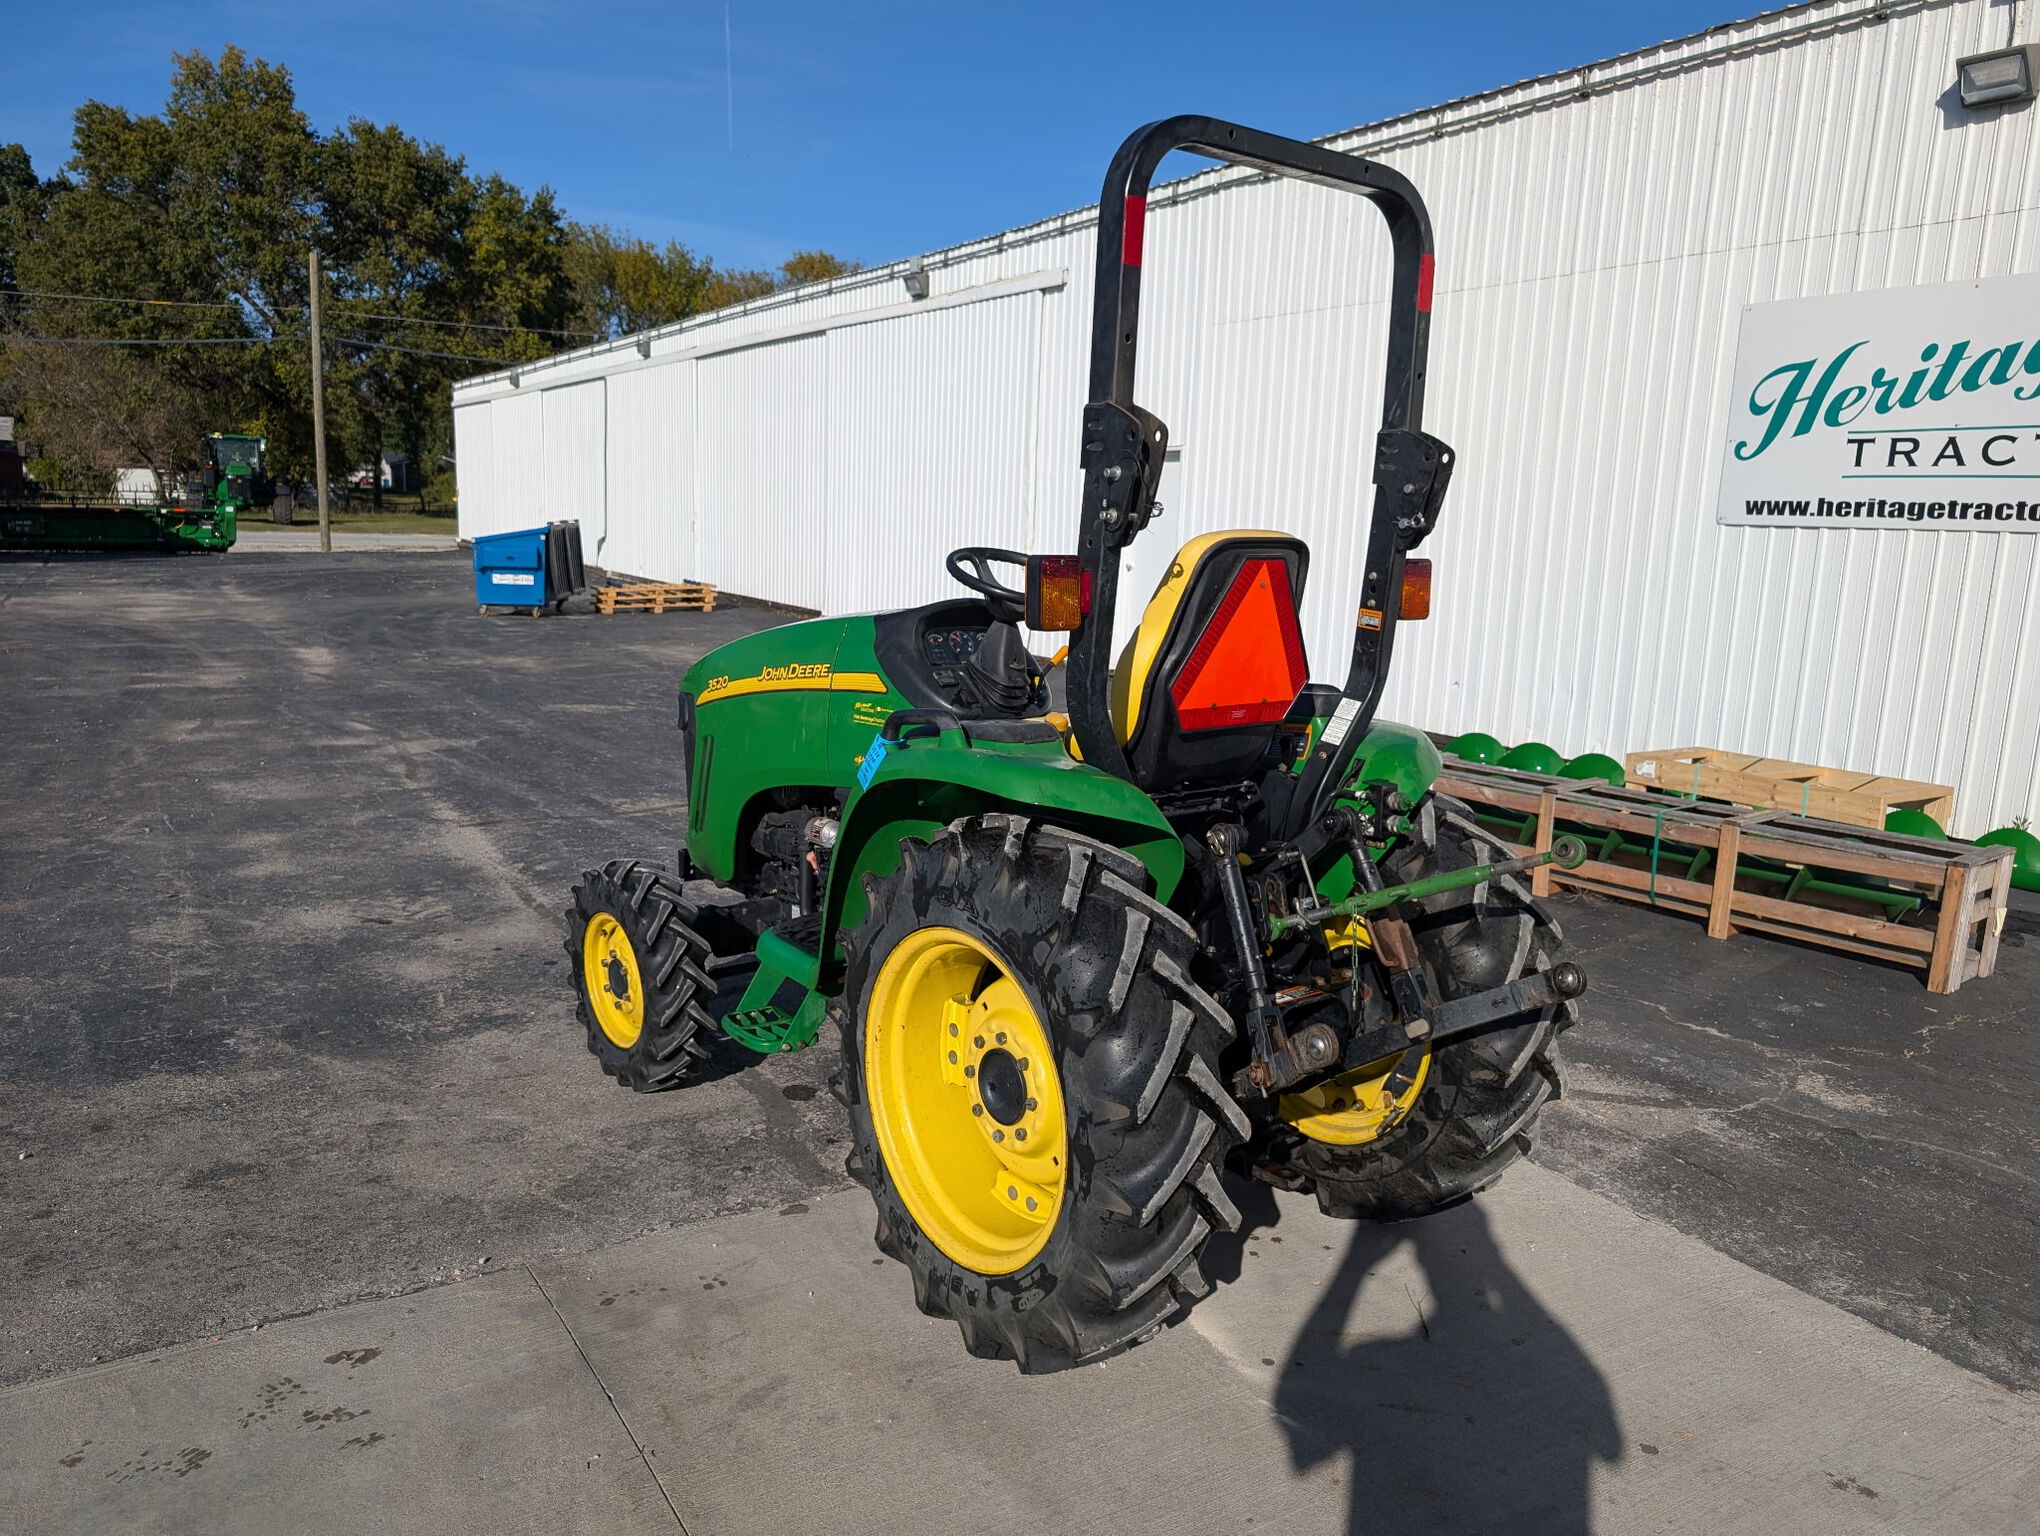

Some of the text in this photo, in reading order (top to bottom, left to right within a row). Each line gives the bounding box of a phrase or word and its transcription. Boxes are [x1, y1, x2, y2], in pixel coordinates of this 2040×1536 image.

[1847, 432, 2040, 467] TRAC
[1745, 497, 2040, 521] www.heritagetracto
[707, 675, 729, 693] 3520
